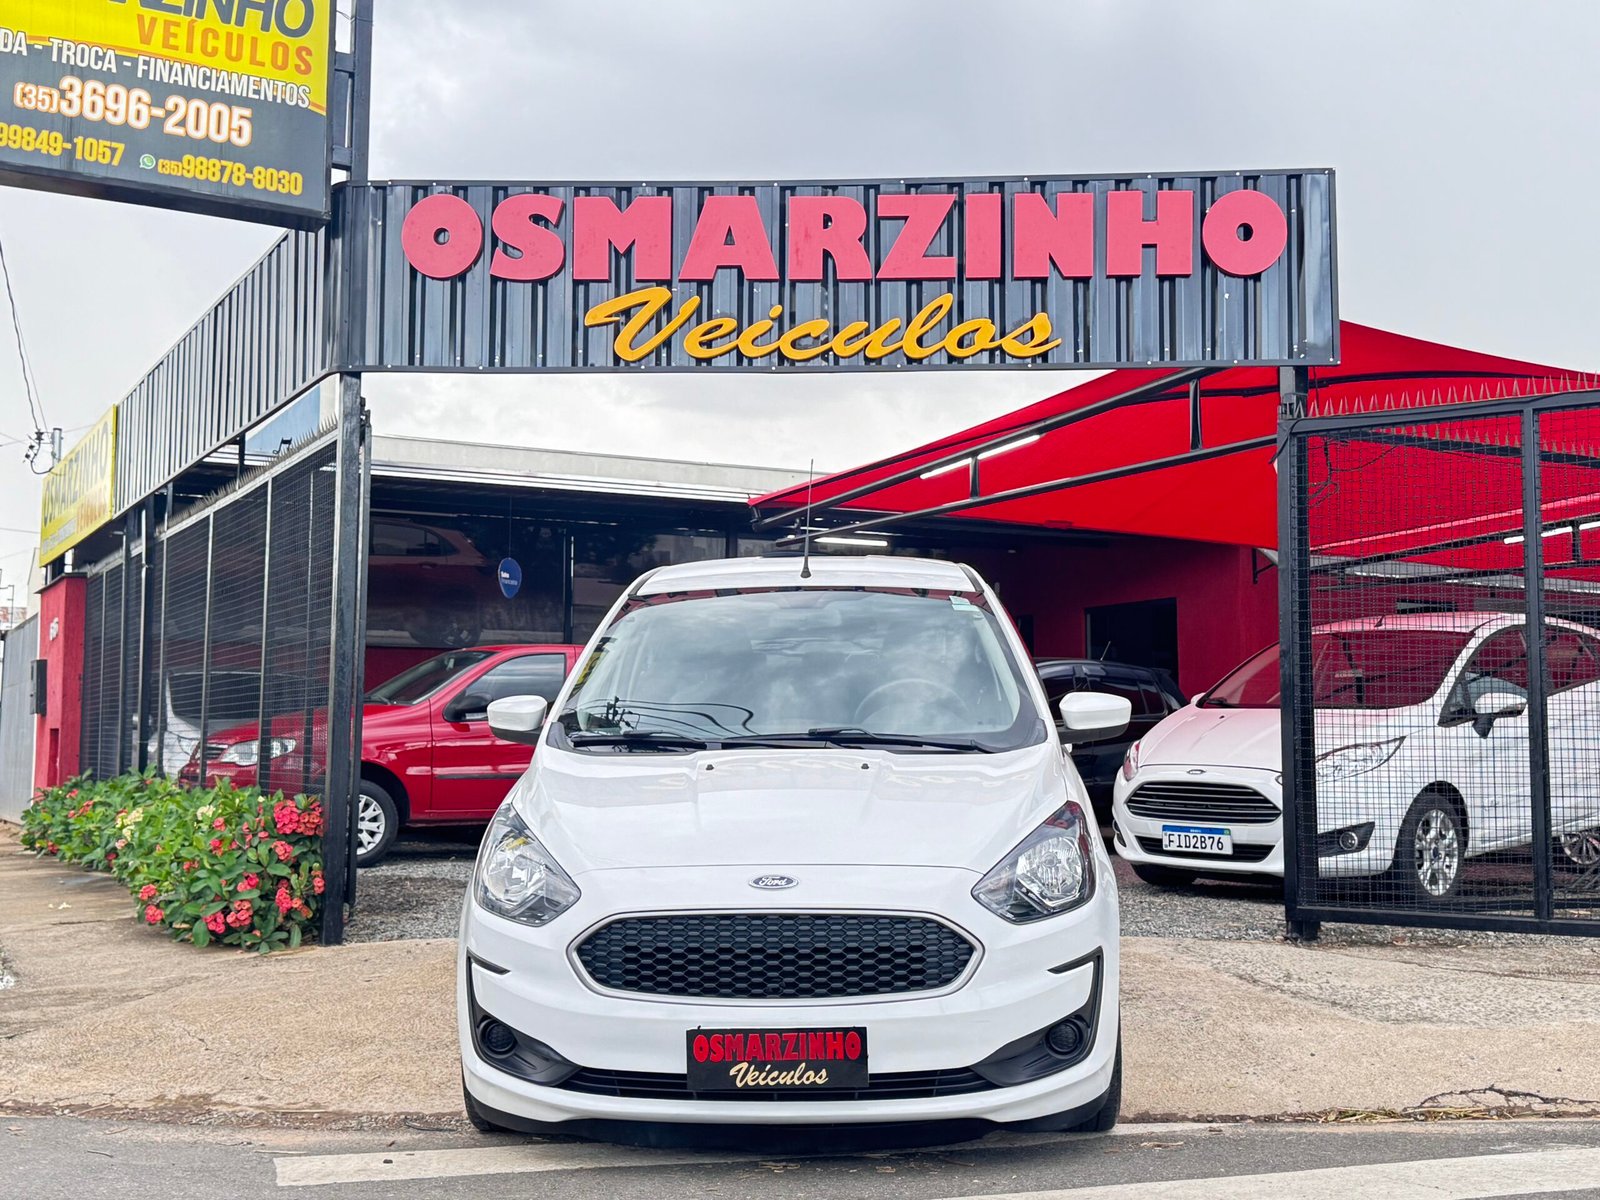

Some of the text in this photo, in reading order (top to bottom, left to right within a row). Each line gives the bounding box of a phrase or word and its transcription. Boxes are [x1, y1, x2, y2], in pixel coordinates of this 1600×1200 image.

[49, 37, 118, 73] TROCA
[136, 54, 312, 108] FINANCIAMENTOS
[136, 14, 313, 76] VEÍCULOS
[14, 76, 252, 147] (35)3696-2005
[402, 190, 1288, 281] OSMARZINHO
[1168, 832, 1224, 851] FID2B76
[759, 876, 788, 887] Ford
[693, 1031, 862, 1063] OSMARZINHO
